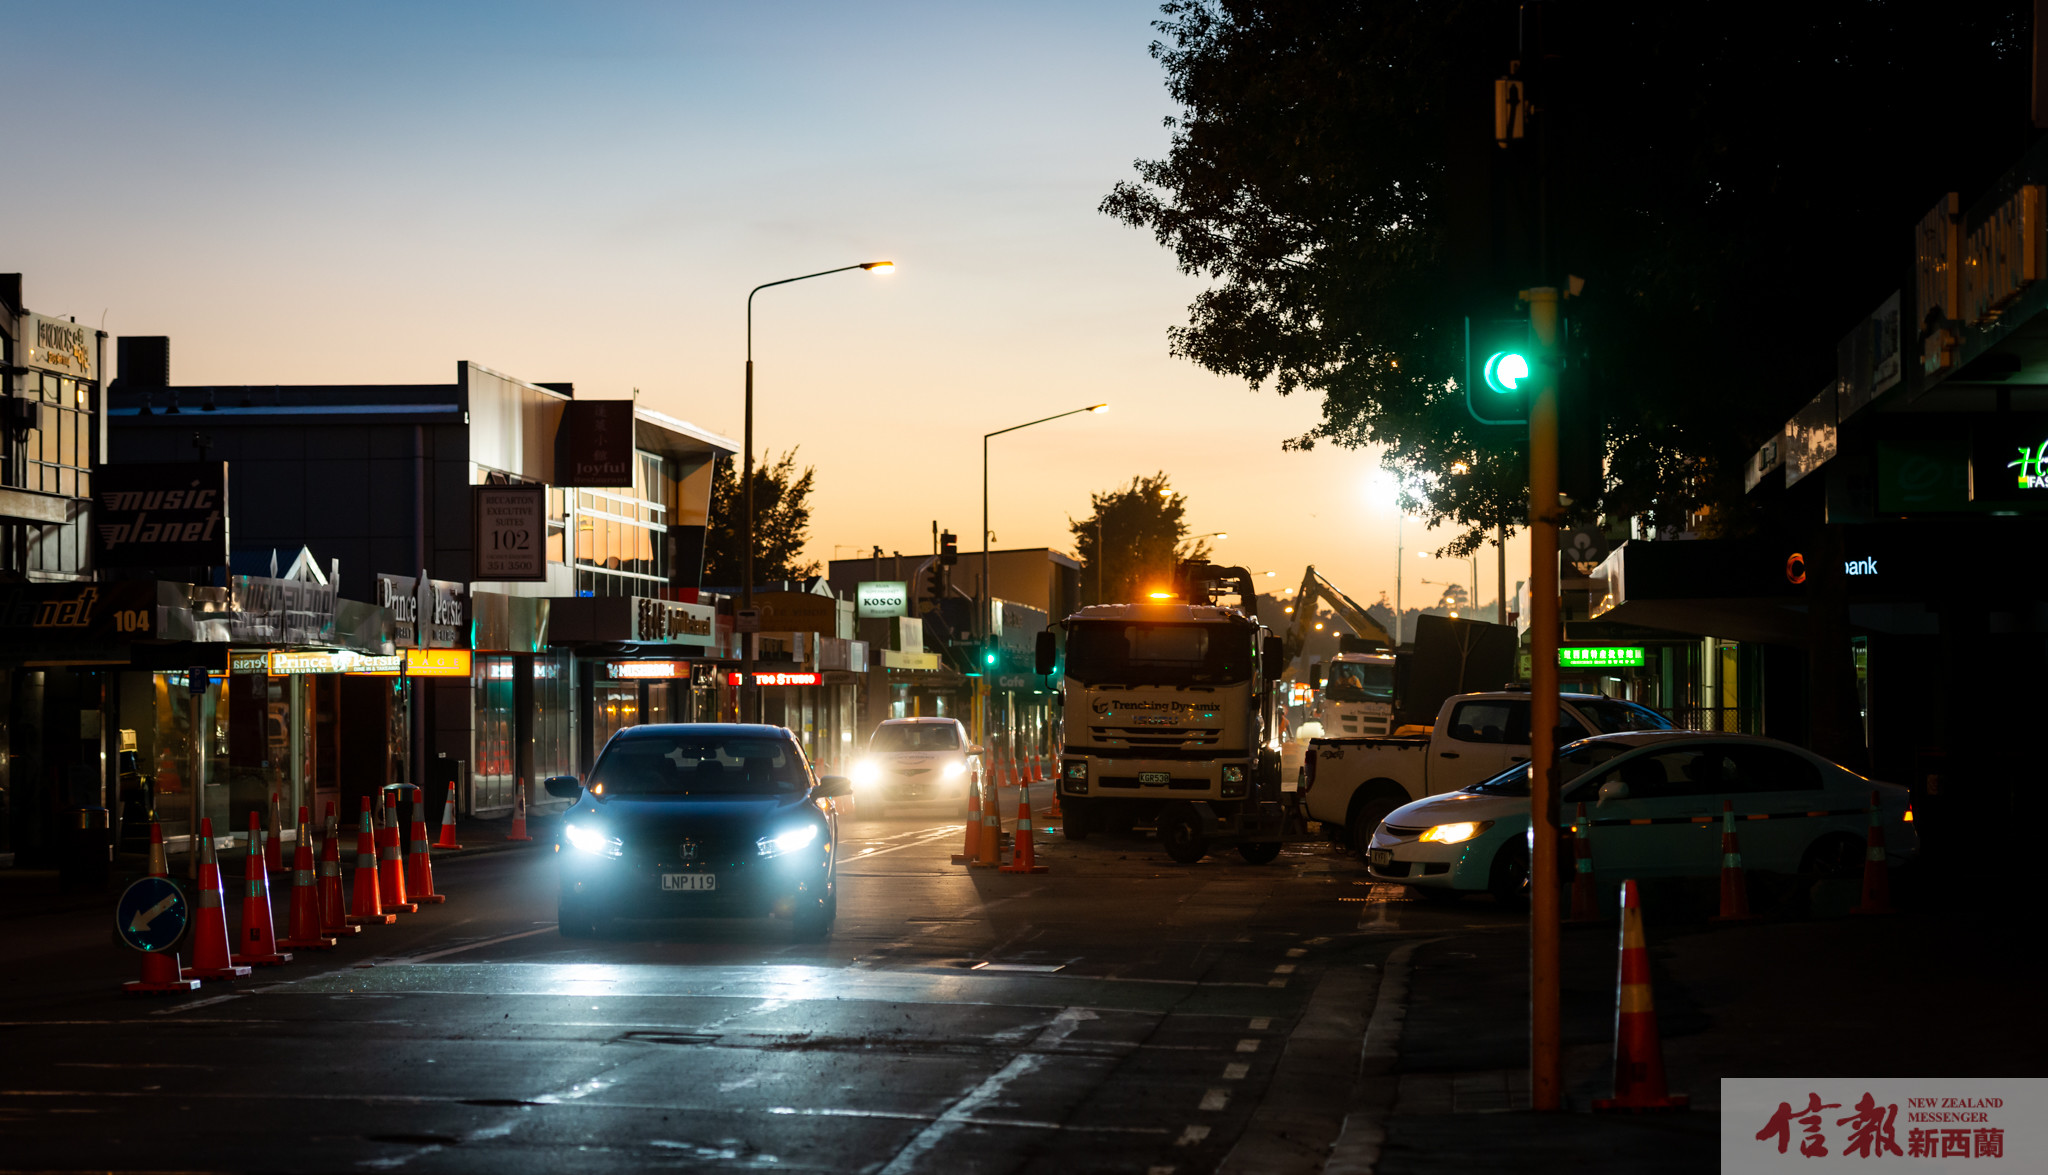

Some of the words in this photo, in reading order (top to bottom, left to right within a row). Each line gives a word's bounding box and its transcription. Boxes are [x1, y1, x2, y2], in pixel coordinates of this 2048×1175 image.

[576, 462, 626, 476] Joyful
[100, 479, 217, 512] music
[486, 496, 534, 505] RICCARTON
[487, 507, 533, 515] EXECUTIVE
[496, 517, 525, 526] SUITES
[97, 509, 221, 551] planet
[491, 529, 529, 550] 102
[487, 561, 505, 570] 351
[508, 561, 533, 571] 3500
[434, 584, 463, 626] Persia
[863, 598, 902, 606] KOSCO
[113, 610, 150, 633] 104
[274, 654, 328, 668] Prince
[353, 654, 401, 667] Persia
[1000, 675, 1025, 688] Cafe
[1112, 700, 1169, 712] Trenching
[1171, 701, 1221, 713] Dynamix
[1132, 716, 1179, 725] ISUZU
[663, 875, 714, 889] LNP119
